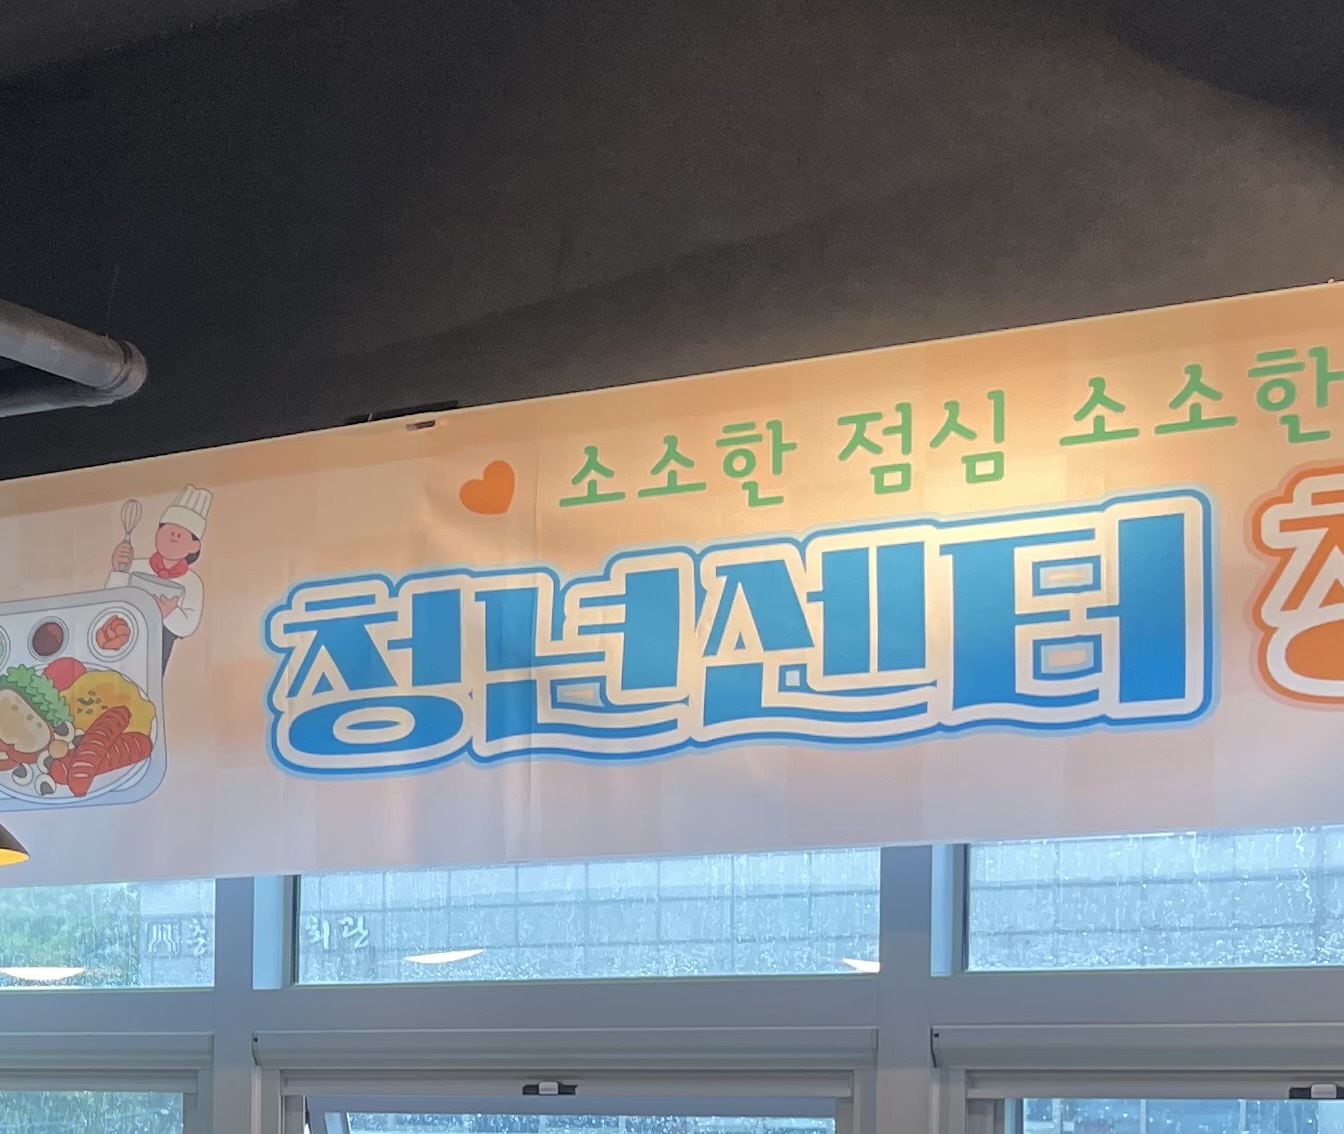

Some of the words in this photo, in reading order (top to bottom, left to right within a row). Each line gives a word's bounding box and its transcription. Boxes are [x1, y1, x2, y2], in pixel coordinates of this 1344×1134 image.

[558, 419, 799, 508] 소소한
[837, 390, 1008, 496] 점심
[1058, 345, 1344, 447] 소소한
